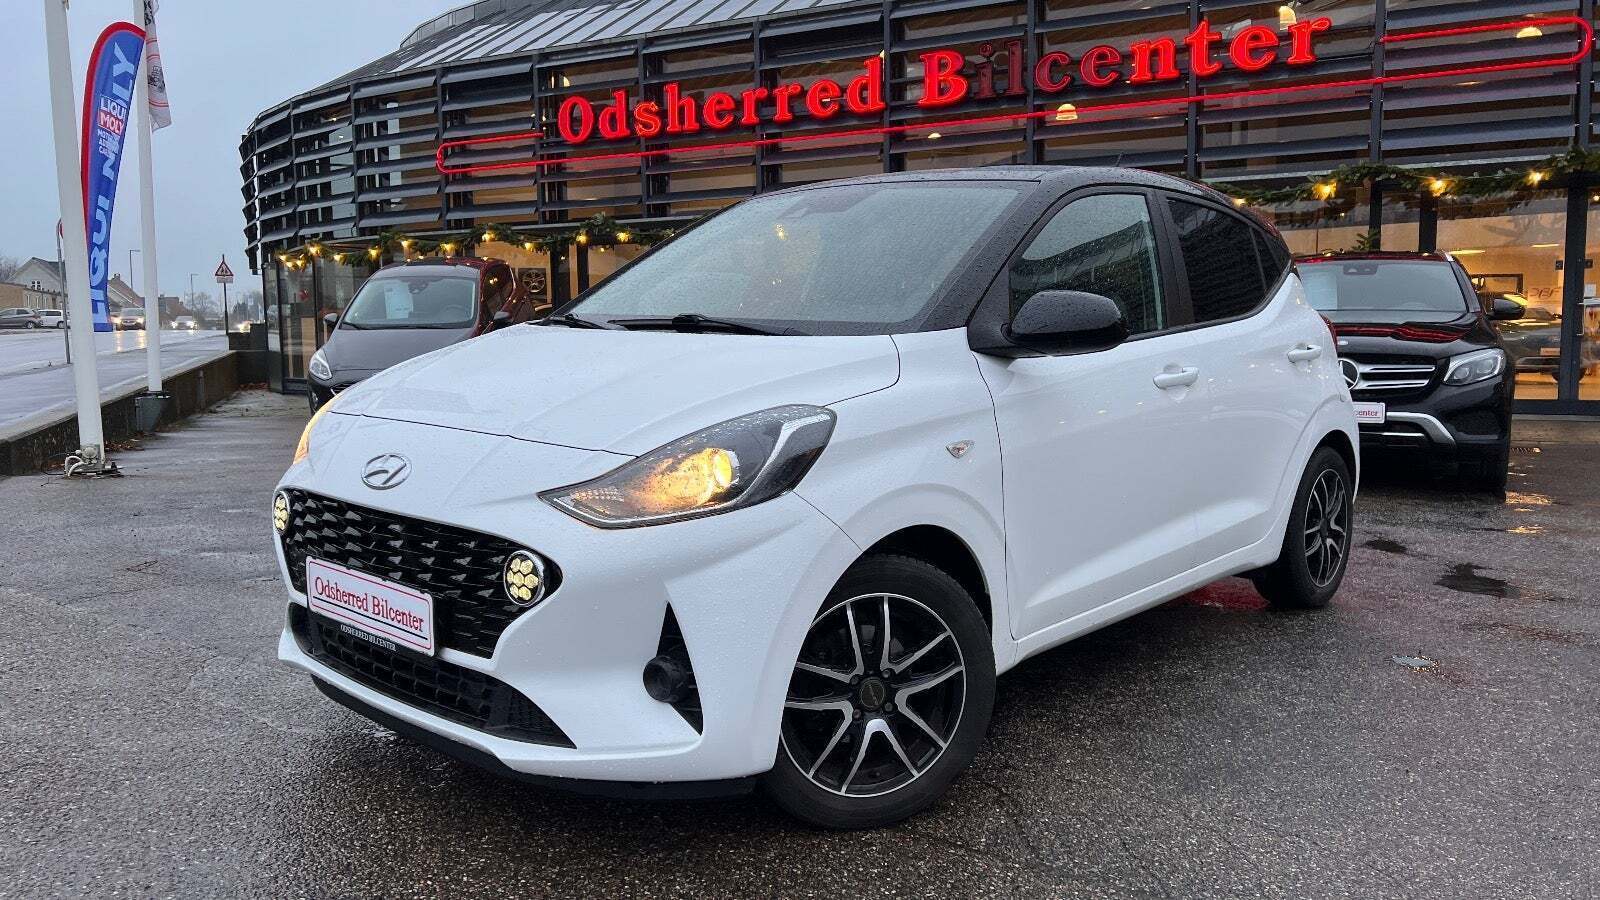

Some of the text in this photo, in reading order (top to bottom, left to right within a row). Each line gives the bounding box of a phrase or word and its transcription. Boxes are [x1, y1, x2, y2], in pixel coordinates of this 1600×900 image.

[558, 16, 1332, 144] Odsherred Bilcenter
[101, 97, 126, 121] LIQUI
[100, 112, 124, 135] MOLY
[315, 576, 424, 632] Odsherred Bilcenter
[340, 624, 396, 652] ODSHERRED BILCENTER
